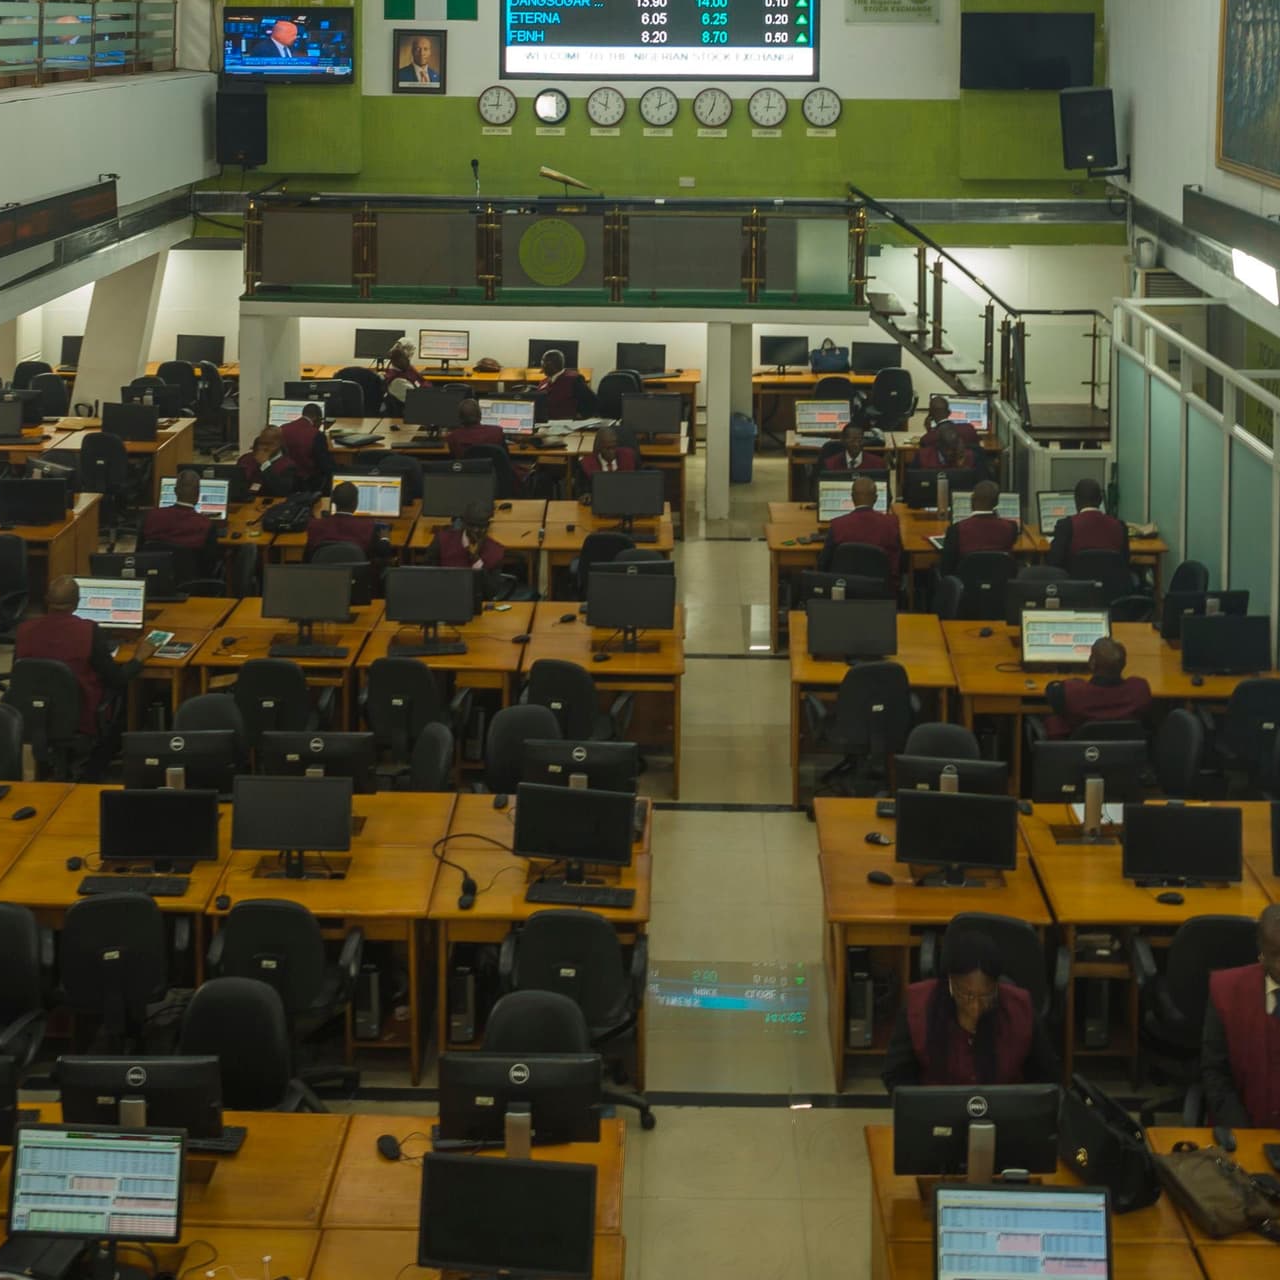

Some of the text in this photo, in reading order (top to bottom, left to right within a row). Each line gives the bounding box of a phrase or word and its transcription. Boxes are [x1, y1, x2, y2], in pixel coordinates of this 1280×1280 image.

[510, 12, 561, 24] ETERNA
[641, 12, 668, 25] 6.05
[701, 13, 728, 25] 6.25
[765, 14, 789, 25] 0.20
[510, 30, 544, 42] FBNH
[641, 31, 668, 43] 8.20
[701, 31, 728, 43] 8.70
[765, 32, 789, 43] 0.50
